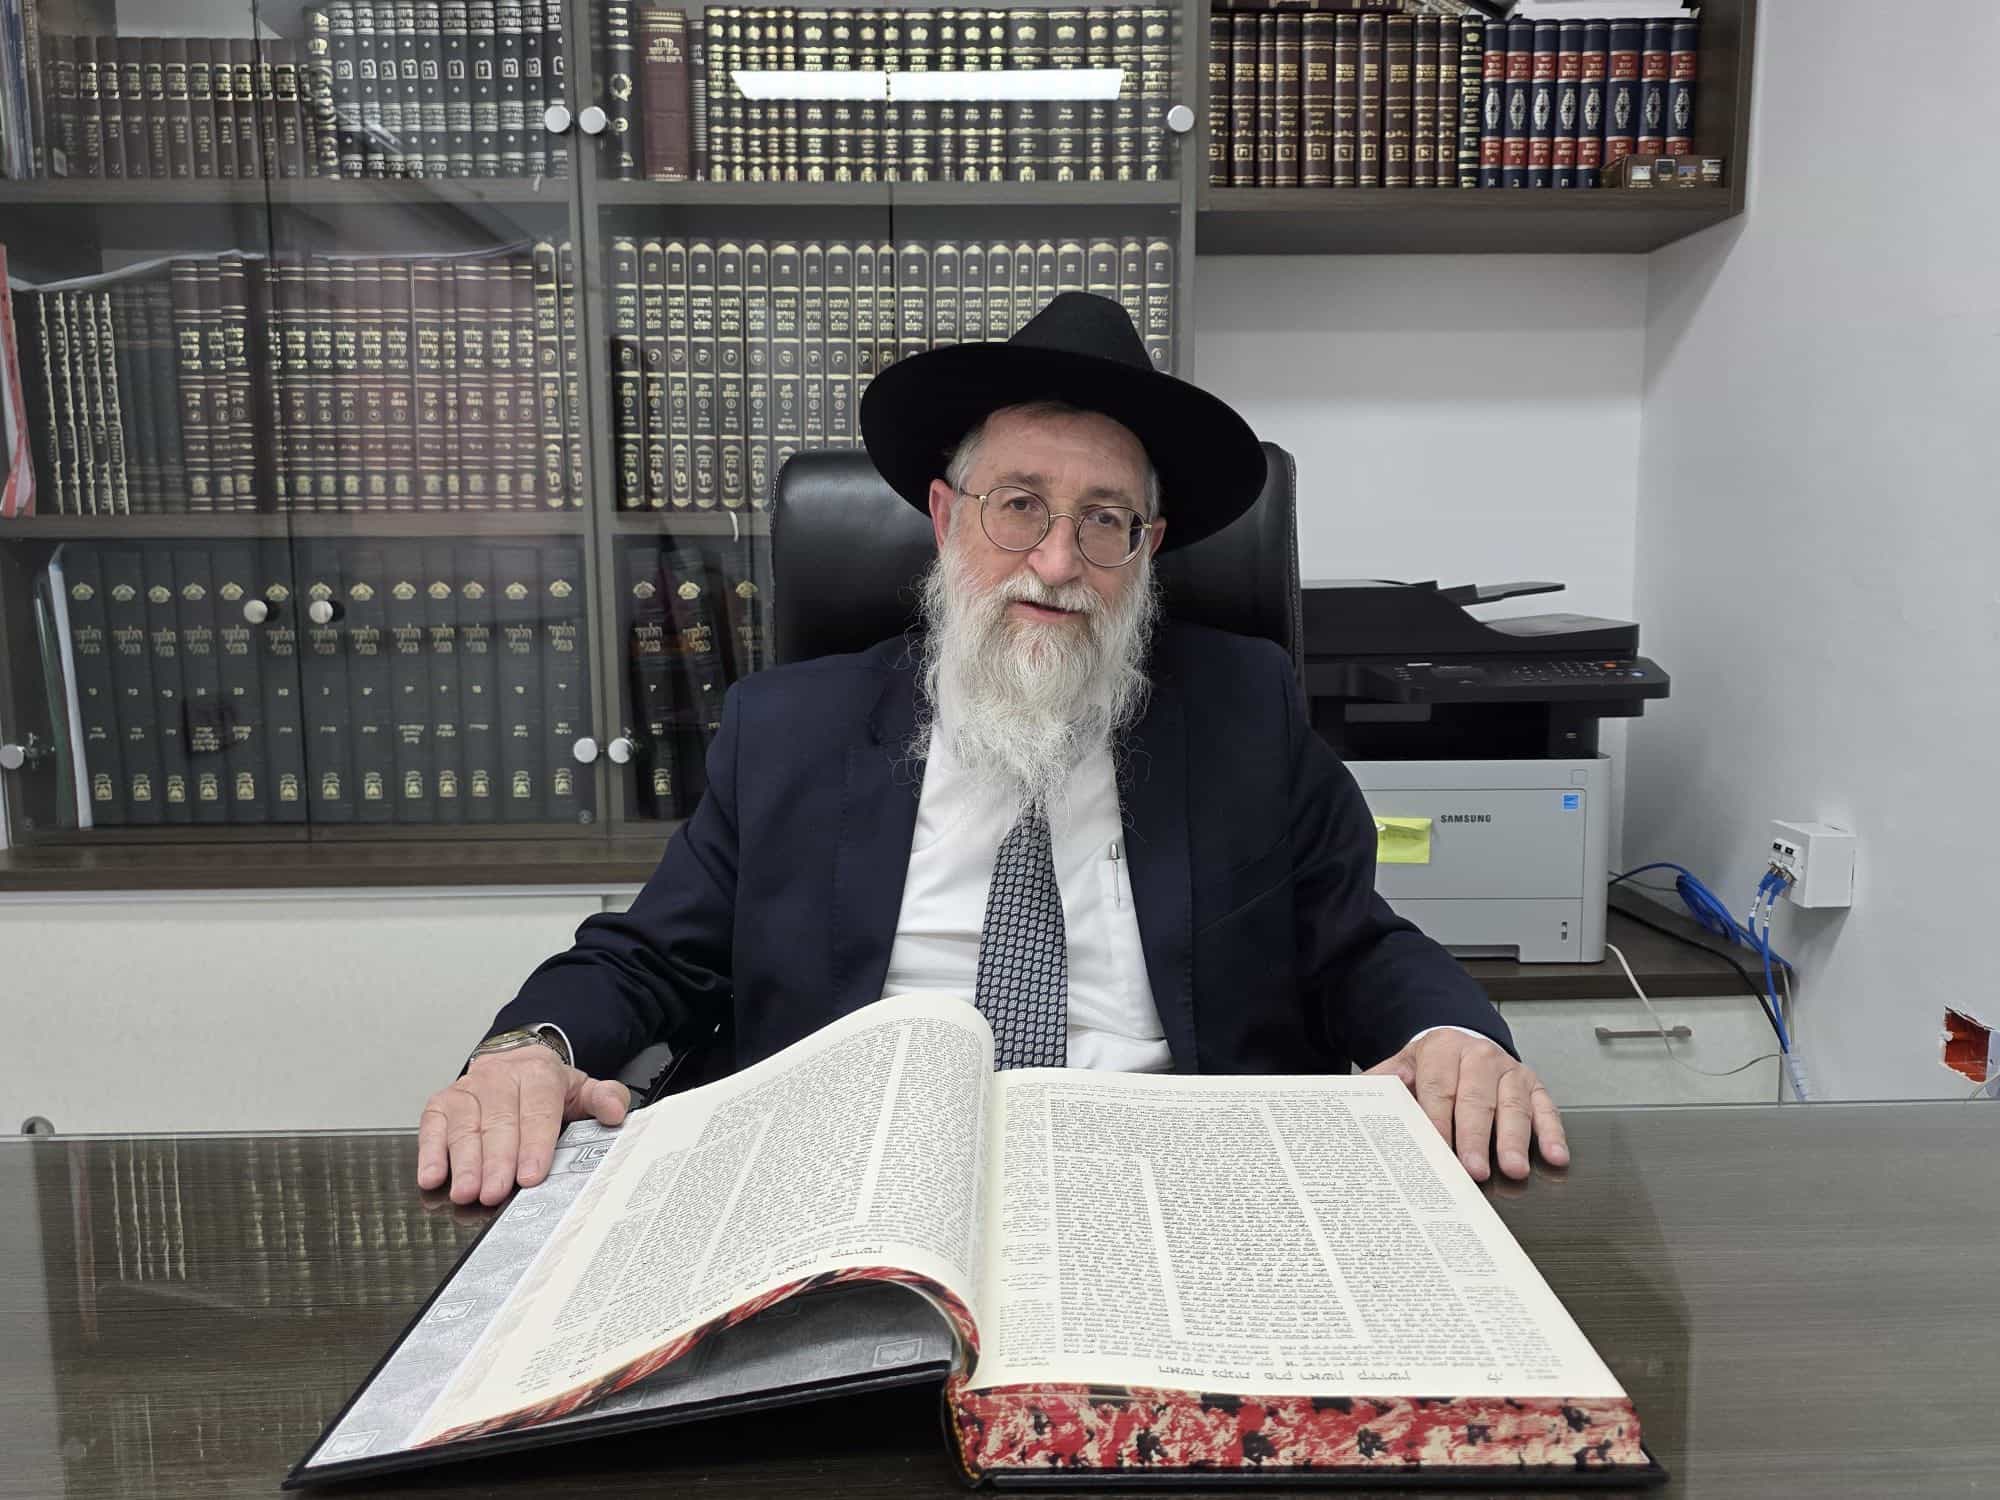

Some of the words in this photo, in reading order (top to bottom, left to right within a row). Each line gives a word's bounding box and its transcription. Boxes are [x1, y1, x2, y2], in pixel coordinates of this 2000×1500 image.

[74, 626, 101, 643] תלמוד
[112, 626, 143, 643] תלמוד
[152, 627, 176, 644] תלמוד
[183, 625, 212, 642] תלמוד
[220, 624, 249, 641] תלמוד
[266, 626, 294, 643] תלמוד
[310, 626, 337, 643] תלמוד
[352, 625, 379, 642] תלמוד
[393, 623, 421, 640] תלמוד
[430, 623, 454, 640] תלמוד
[463, 623, 488, 640] תלמוד
[505, 624, 532, 641] תלמוד
[549, 621, 575, 638] תלמוד
[635, 622, 663, 639] תלמוד
[682, 622, 712, 639] תלמוד
[79, 640, 100, 654] בבלי
[121, 640, 141, 654] בבלי
[156, 642, 174, 656] בבלי
[188, 640, 209, 654] בבלי
[226, 640, 247, 654] בבלי
[272, 641, 292, 655] בבלי
[315, 640, 335, 654] בבלי
[356, 640, 376, 654] בבלי
[398, 640, 418, 654] בבלי
[434, 639, 452, 653] בבלי
[466, 639, 487, 653] בבלי
[509, 639, 529, 653] בבלי
[553, 637, 573, 651] בבלי
[639, 639, 661, 653] בבלי
[688, 639, 711, 653] בבלי
[1440, 814, 1492, 823] SAMSUNG
[1158, 1365, 1205, 1376] האשה
[1212, 1369, 1250, 1380] נקנית
[1264, 1370, 1294, 1380] פרק
[1301, 1369, 1344, 1380] ראשון
